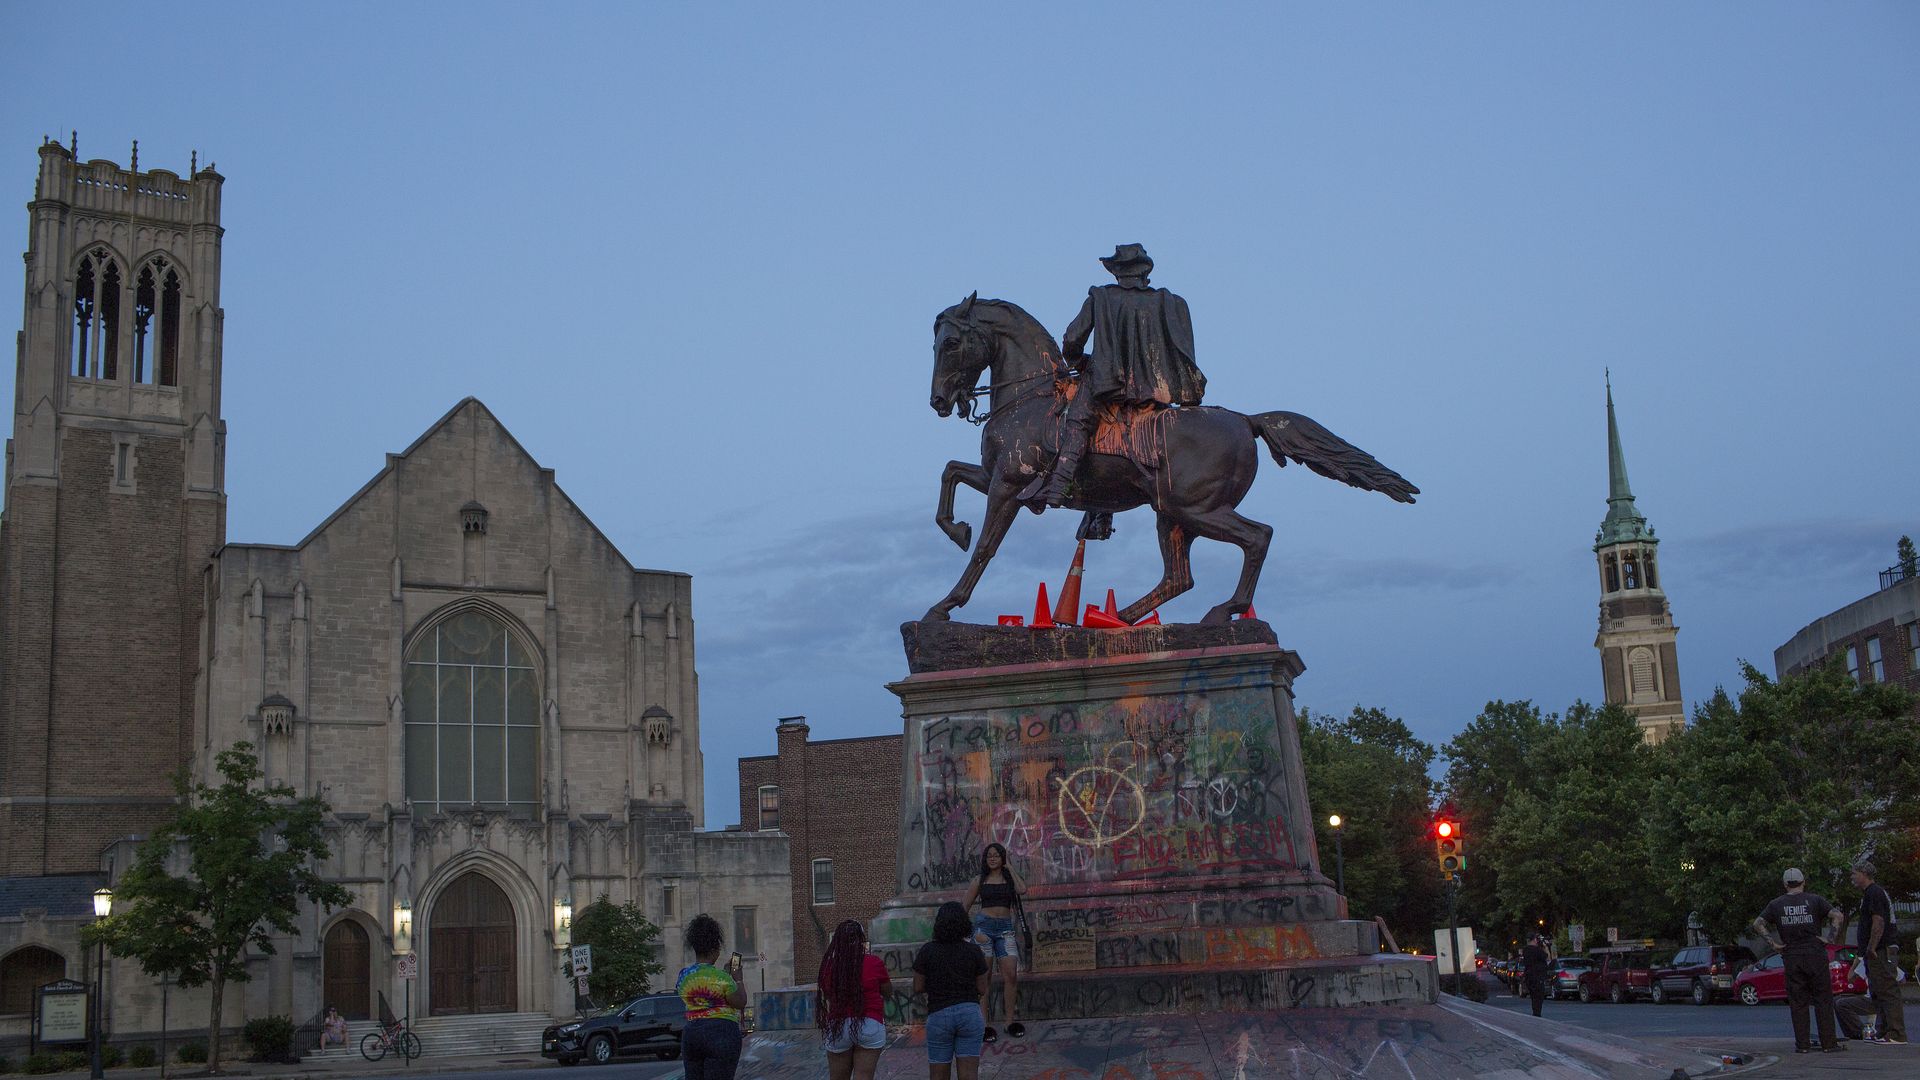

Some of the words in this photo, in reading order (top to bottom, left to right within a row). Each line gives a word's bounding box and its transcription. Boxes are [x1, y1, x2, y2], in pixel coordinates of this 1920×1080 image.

[1112, 831, 1174, 866] END
[1186, 815, 1297, 869] RACISM
[1783, 904, 1809, 916] VENUE
[1036, 928, 1095, 943] CAREFUL
[1205, 923, 1320, 962] BLM
[574, 948, 588, 957] ONE
[574, 956, 588, 965] WAY
